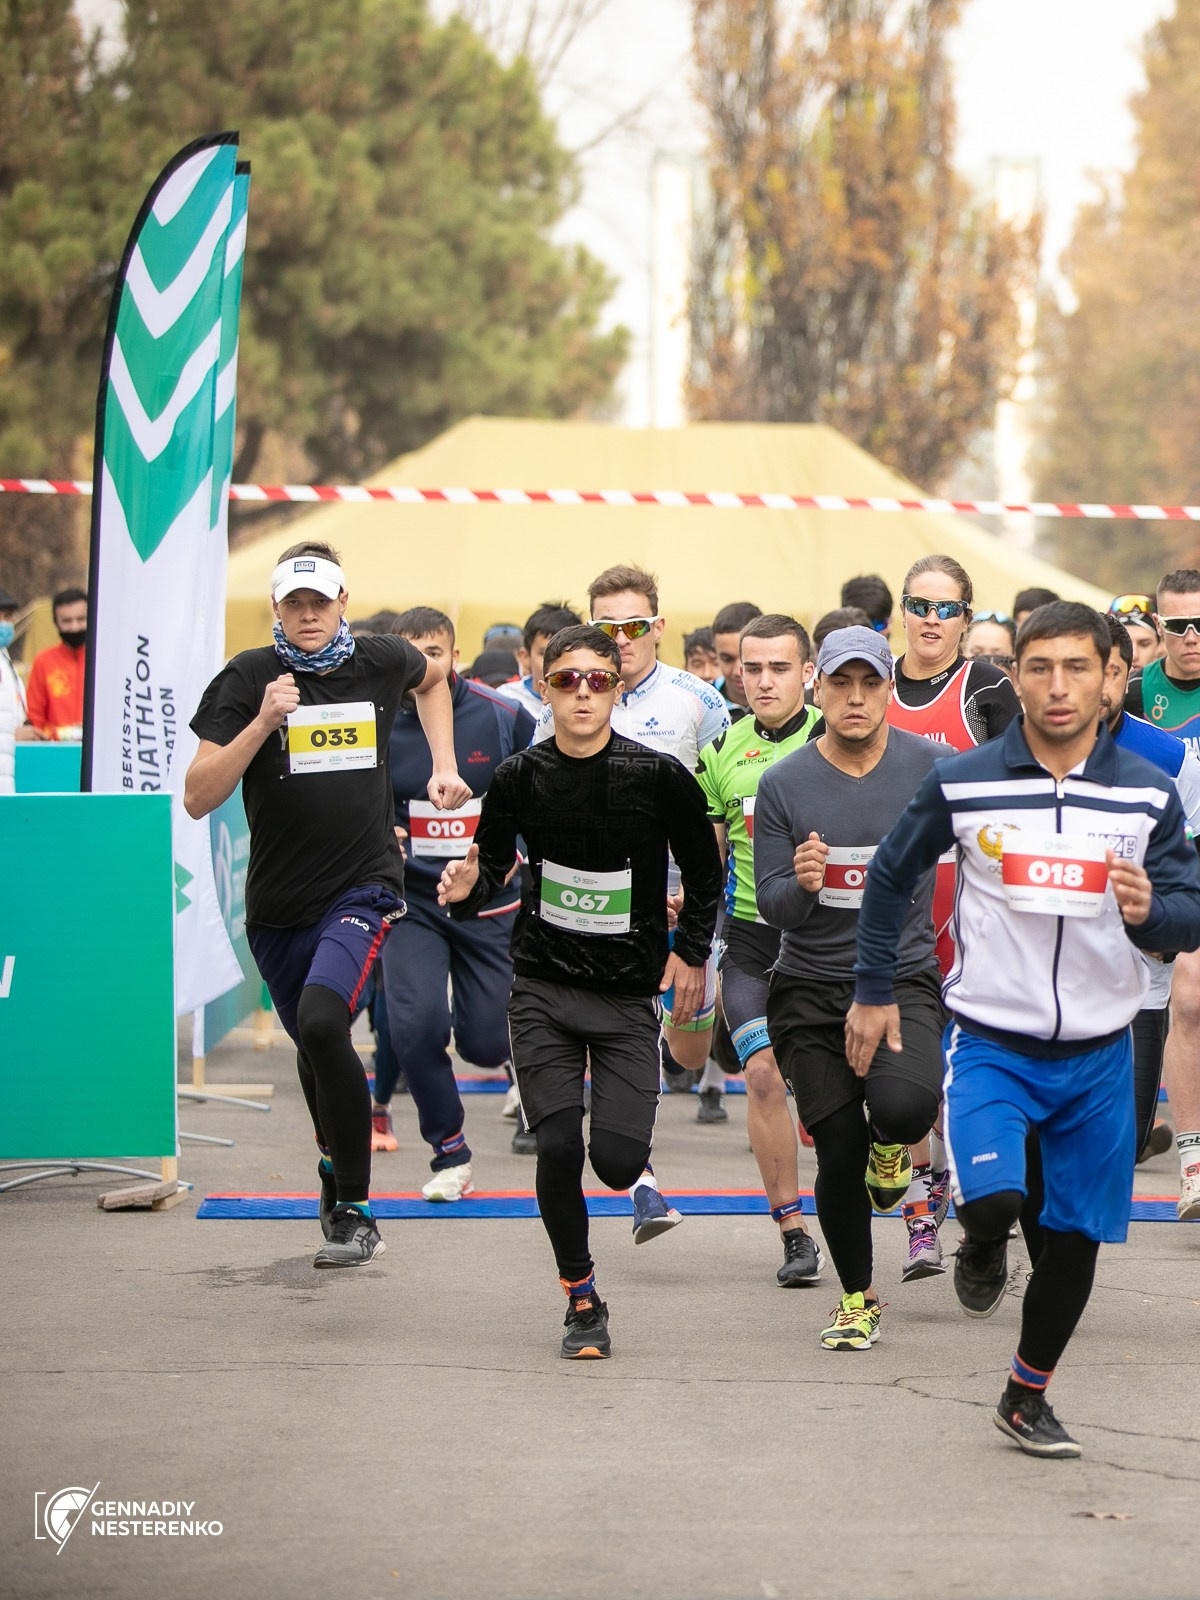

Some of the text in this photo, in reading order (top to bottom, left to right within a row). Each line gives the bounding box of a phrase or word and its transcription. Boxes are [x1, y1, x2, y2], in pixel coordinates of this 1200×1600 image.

[136, 634, 161, 792] RIATHLON
[122, 677, 134, 791] BEKISTAN
[310, 727, 358, 748] 033
[427, 820, 466, 837] 010
[1088, 832, 1138, 859] ZB
[844, 869, 868, 887] 0
[1027, 860, 1084, 888] 018
[560, 889, 610, 912] 067
[340, 915, 370, 932] FILA
